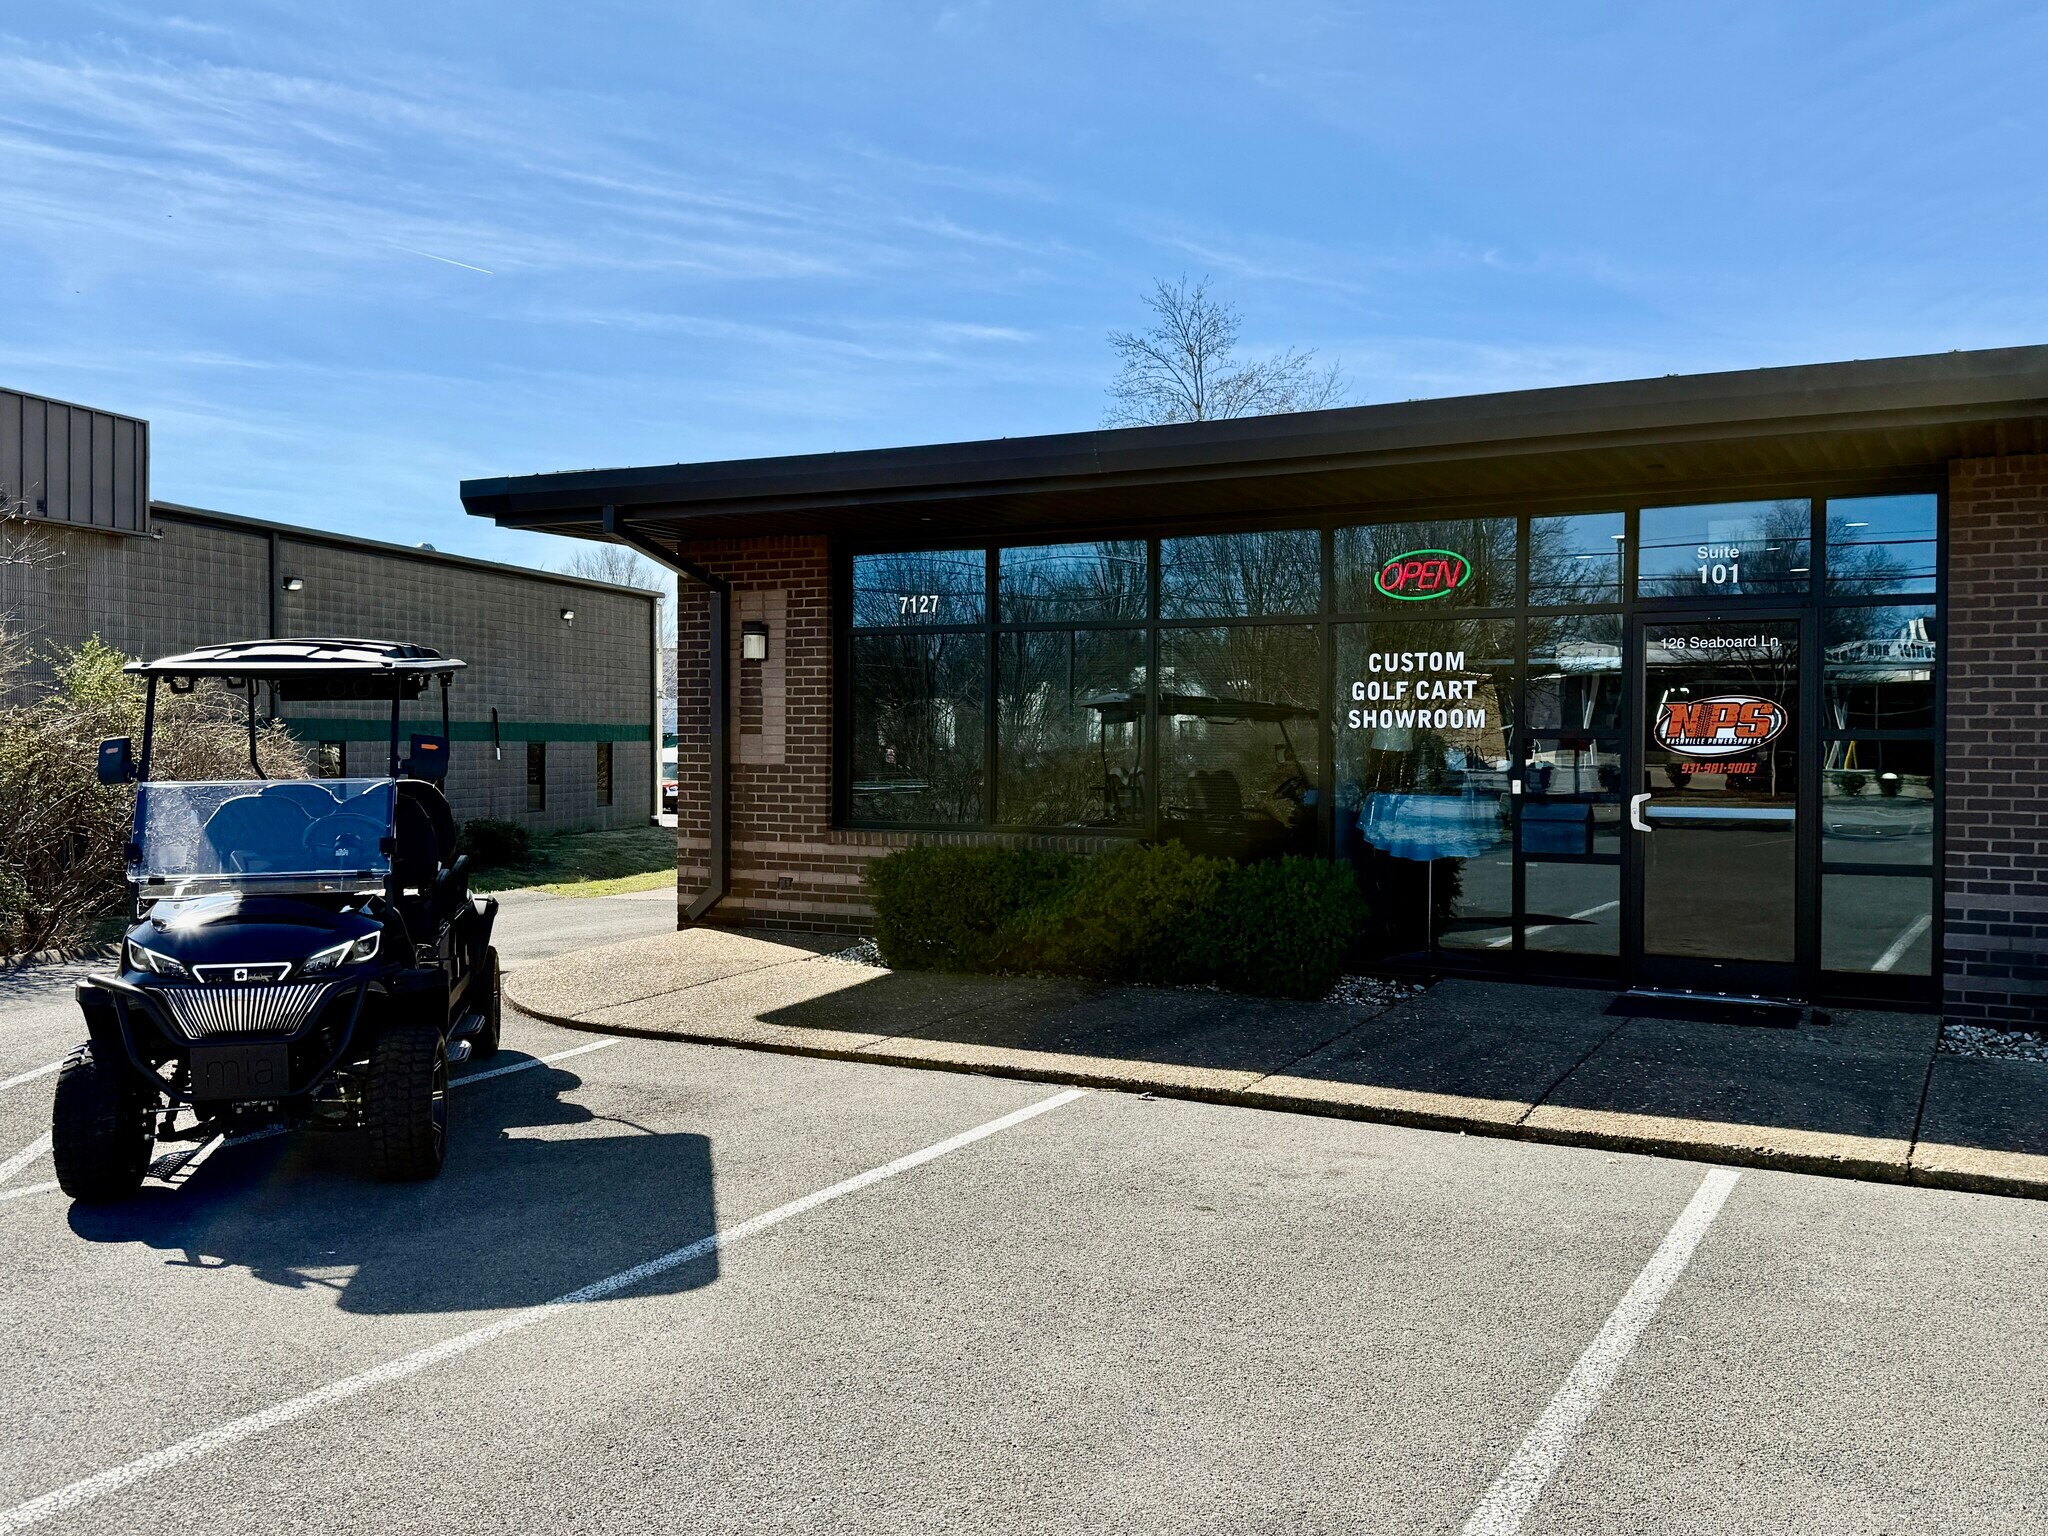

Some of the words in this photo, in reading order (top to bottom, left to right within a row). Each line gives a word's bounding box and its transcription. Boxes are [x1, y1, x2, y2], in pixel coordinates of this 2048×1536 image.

[1697, 546, 1740, 559] Suite
[1380, 560, 1463, 591] OPEN
[1697, 563, 1739, 584] 101
[899, 594, 939, 614] 7127
[1660, 637, 1686, 649] 126
[1689, 635, 1757, 649] Seaboard
[1761, 635, 1783, 647] Ln.
[1368, 651, 1465, 673] CUSTOM
[1352, 681, 1409, 701] GOLF
[1416, 680, 1478, 700] CART
[1348, 708, 1486, 730] SHOWROOM
[1665, 702, 1774, 738] NPS
[1707, 737, 1762, 745] POWERSPORTS
[206, 1048, 274, 1087] mia
